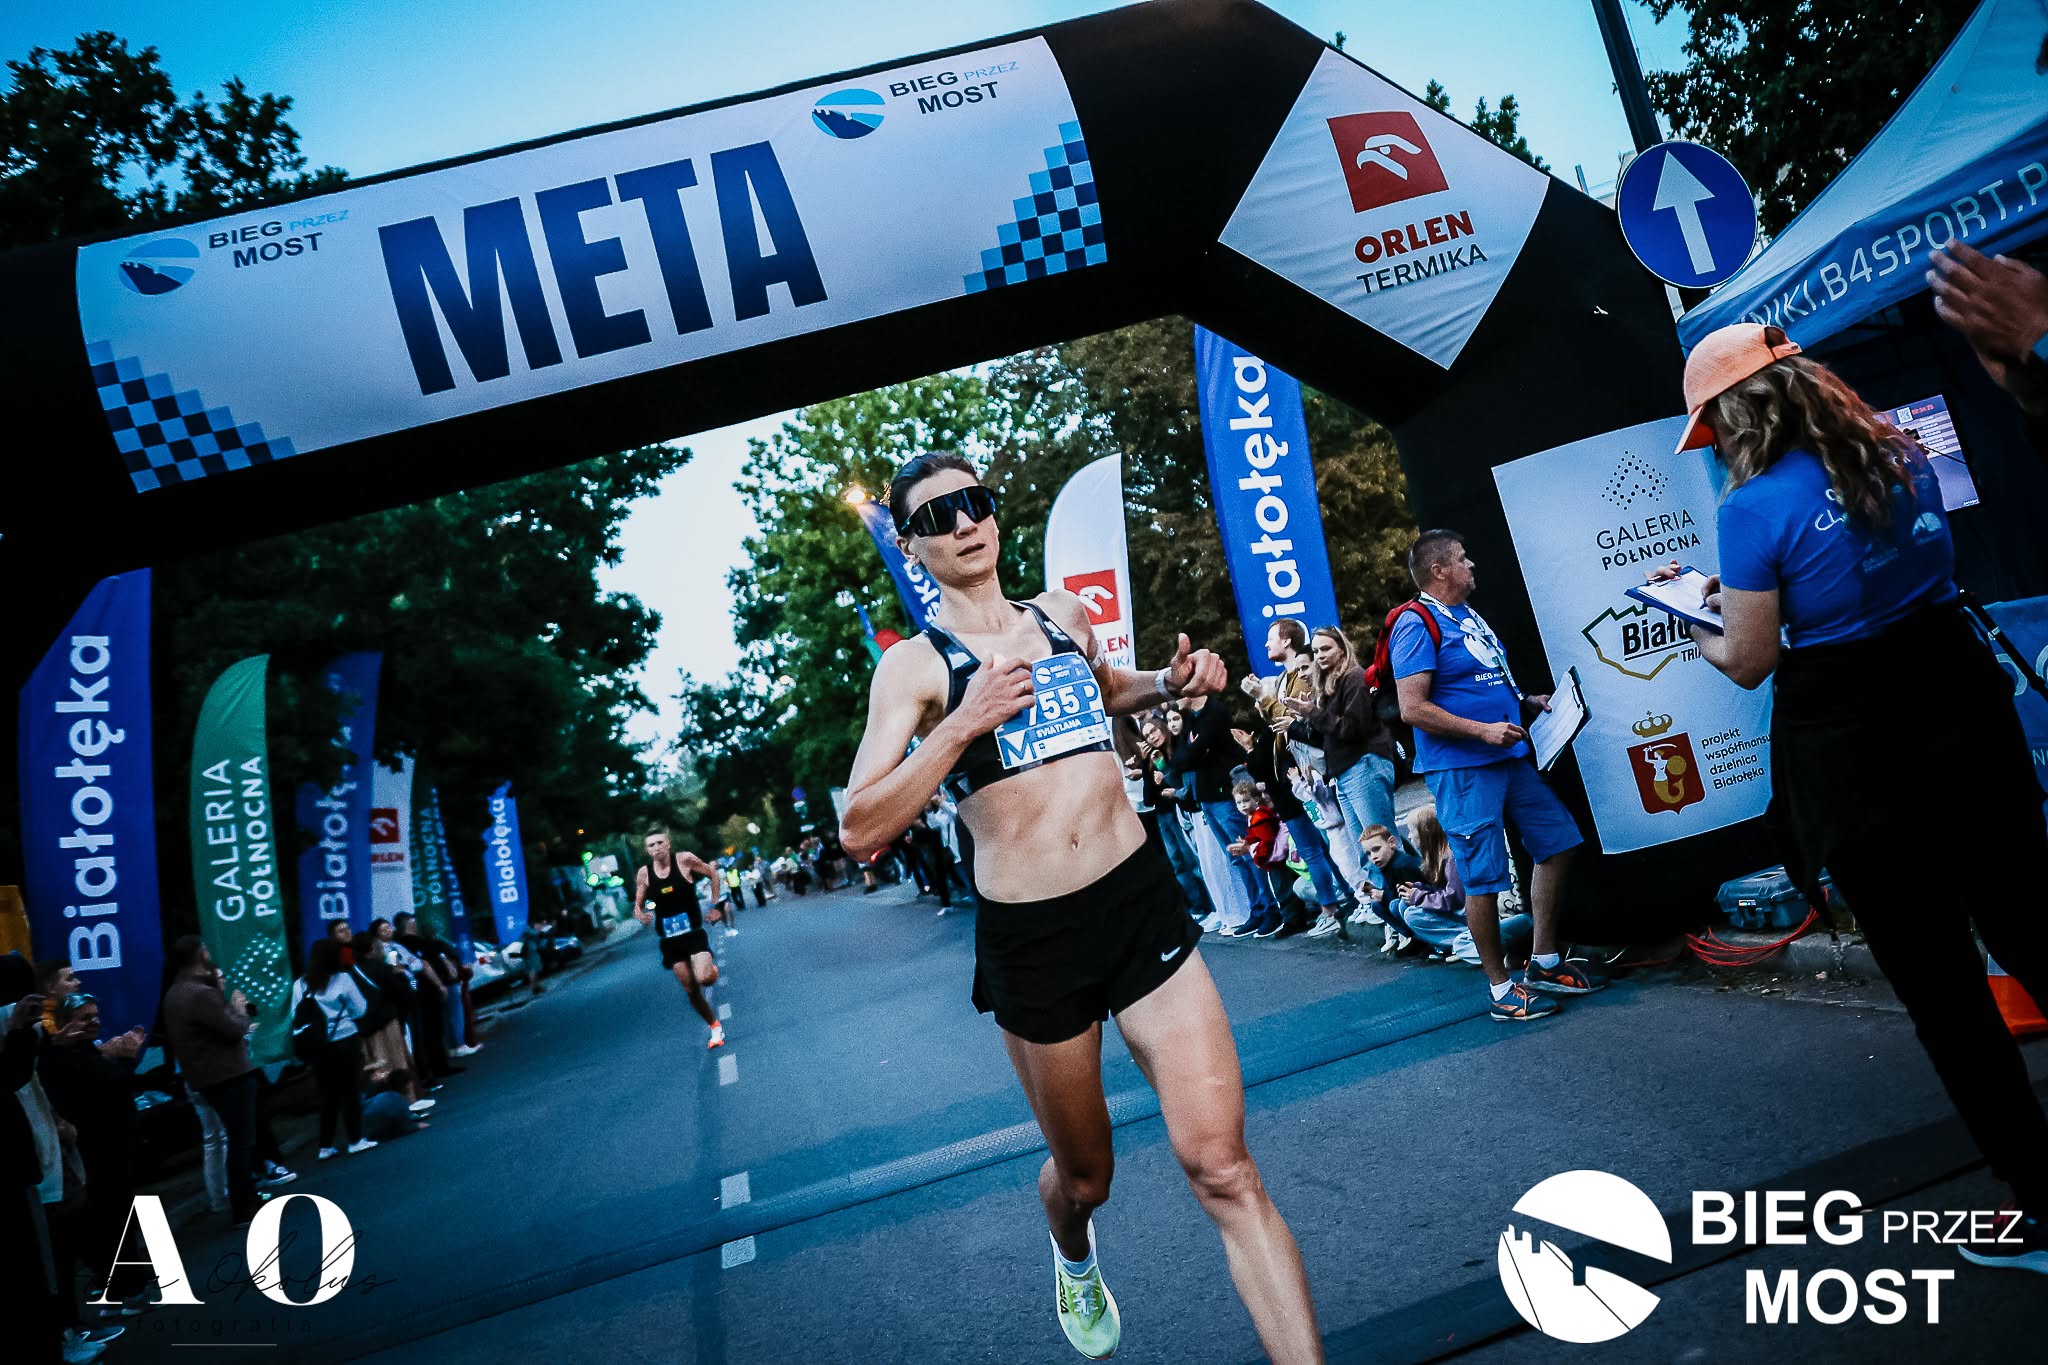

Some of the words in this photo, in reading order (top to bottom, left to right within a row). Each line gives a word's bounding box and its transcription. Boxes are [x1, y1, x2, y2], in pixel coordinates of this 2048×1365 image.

[888, 71, 959, 97] BIEG
[963, 61, 1018, 81] PRZEZ
[917, 81, 998, 114] MOST
[208, 221, 283, 249] BIEG
[289, 209, 349, 232] PRZEZ
[1354, 210, 1475, 264] ORLEN
[232, 231, 323, 269] MOST
[378, 140, 828, 396] META
[1356, 243, 1488, 294] TERMIKA
[1596, 509, 1696, 550] GALERIA
[1601, 532, 1702, 571] PÓŁNOCNA
[1036, 719, 1082, 738] SVIATLANA
[1701, 728, 1741, 749] projekt
[1709, 754, 1758, 776] dzielnica
[1712, 767, 1765, 790] Białołęka
[55, 634, 125, 971] Białołęka
[202, 758, 246, 922] GALERIA
[239, 755, 277, 918] PÓŁNOCNA
